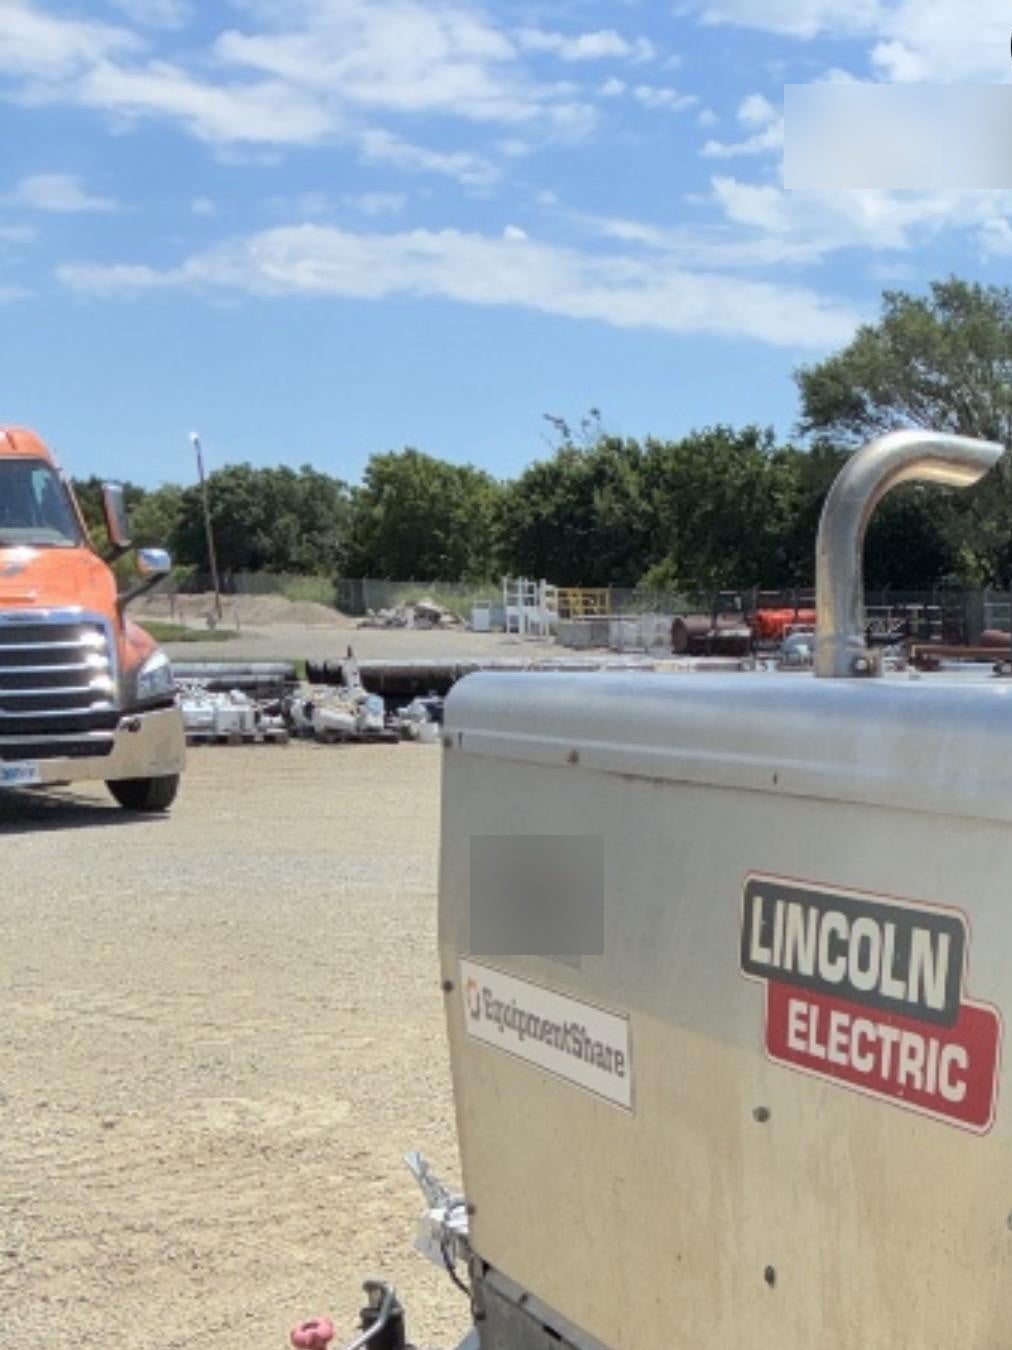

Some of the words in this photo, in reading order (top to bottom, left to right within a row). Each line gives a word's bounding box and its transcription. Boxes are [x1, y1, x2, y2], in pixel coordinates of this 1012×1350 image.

[750, 896, 950, 1011] LINCOLN
[482, 986, 626, 1078] EquipmentShare
[787, 999, 968, 1102] ELECTRIC
